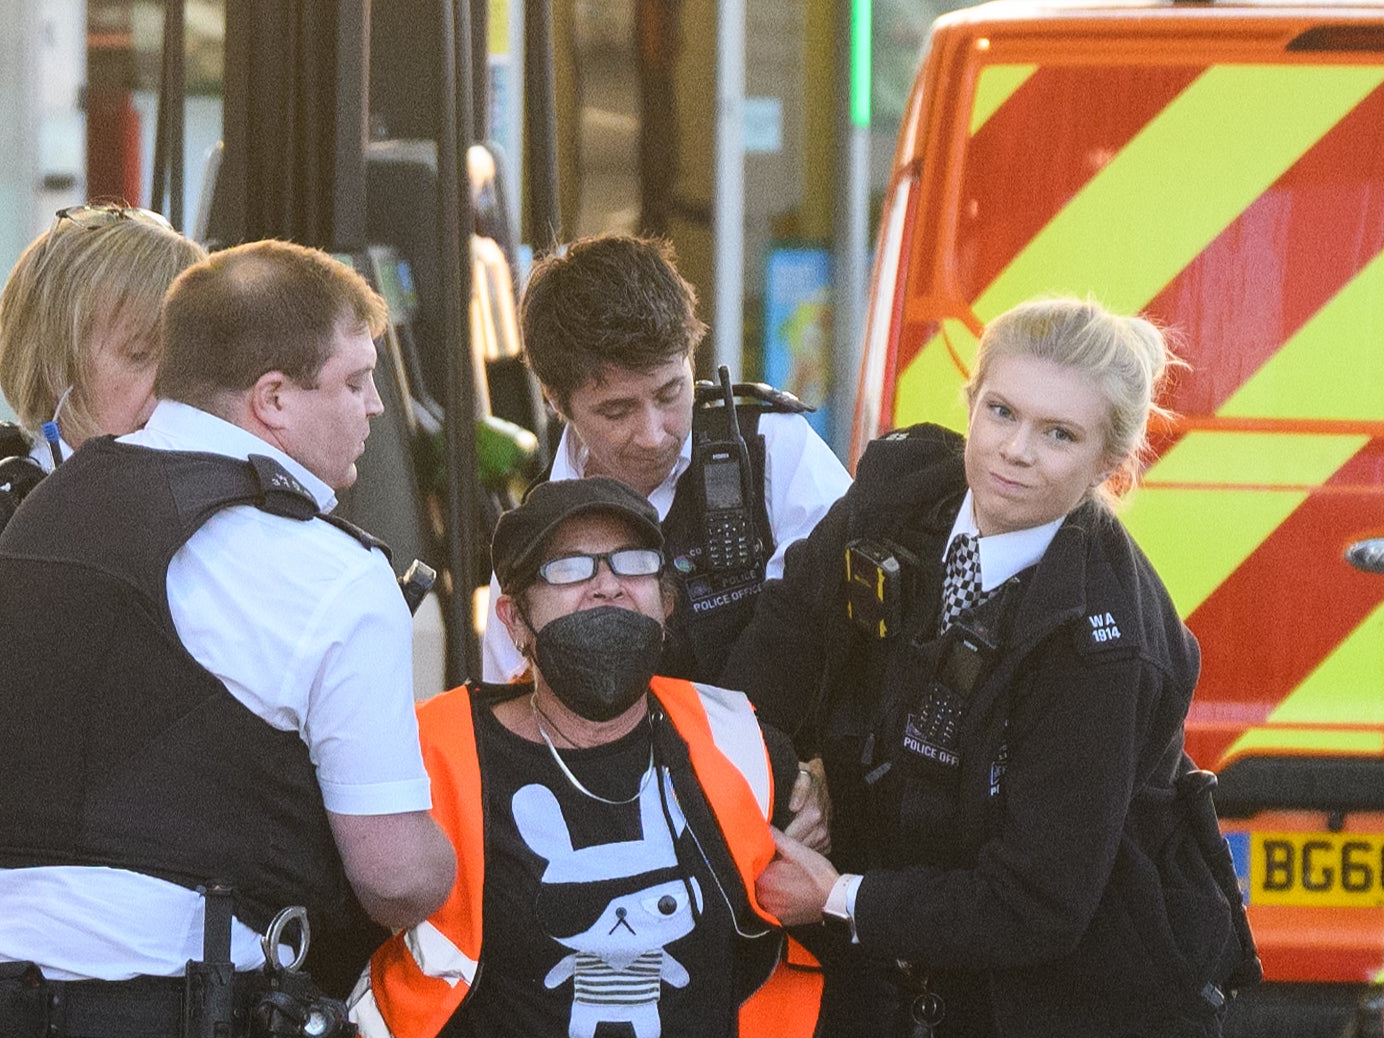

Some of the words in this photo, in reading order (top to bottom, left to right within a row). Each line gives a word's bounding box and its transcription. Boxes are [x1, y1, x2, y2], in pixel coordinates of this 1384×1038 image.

[693, 593, 731, 613] POLICE
[1089, 611, 1116, 628] WA
[1091, 627, 1122, 644] 1914
[903, 736, 937, 759] POLICE
[1262, 838, 1384, 894] BG6
